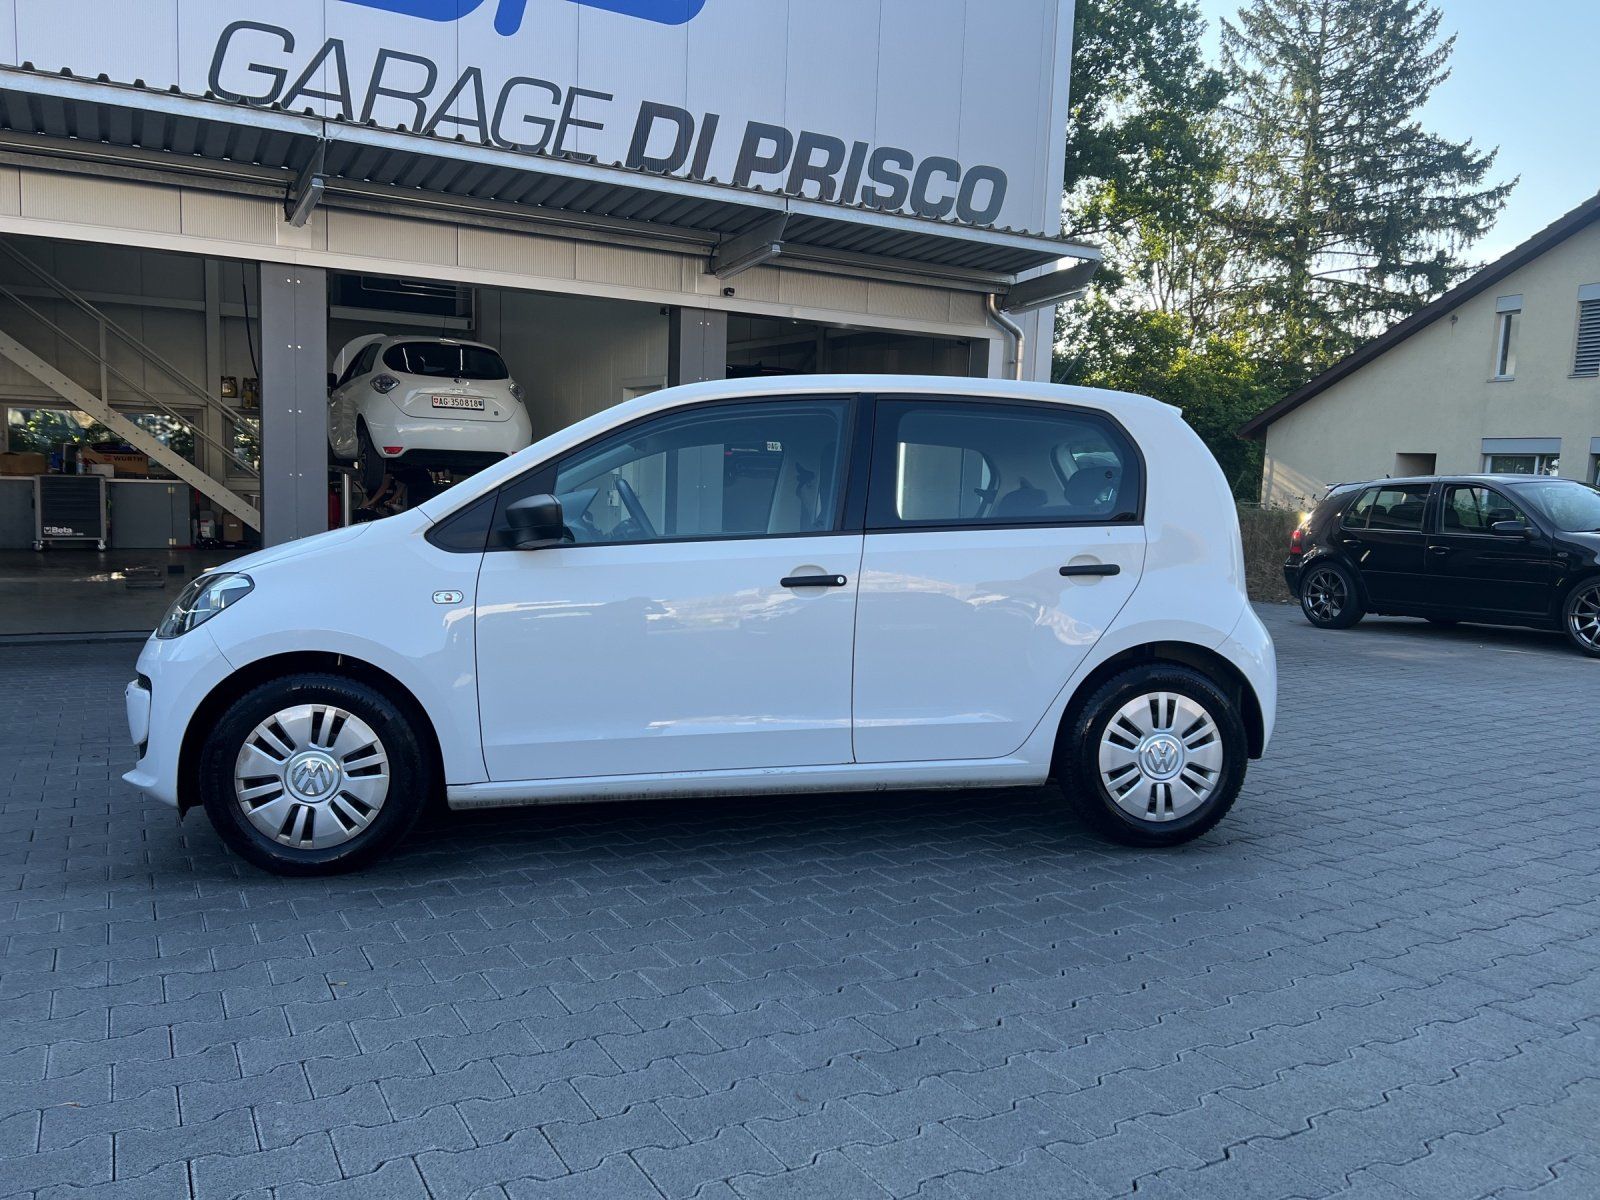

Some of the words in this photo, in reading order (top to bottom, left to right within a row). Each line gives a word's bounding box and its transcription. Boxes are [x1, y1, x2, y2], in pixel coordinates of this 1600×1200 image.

[208, 20, 613, 159] GARAGE
[625, 101, 720, 182] DI
[733, 120, 1008, 225] PRISCO
[439, 397, 448, 406] AG
[450, 398, 479, 408] 350818
